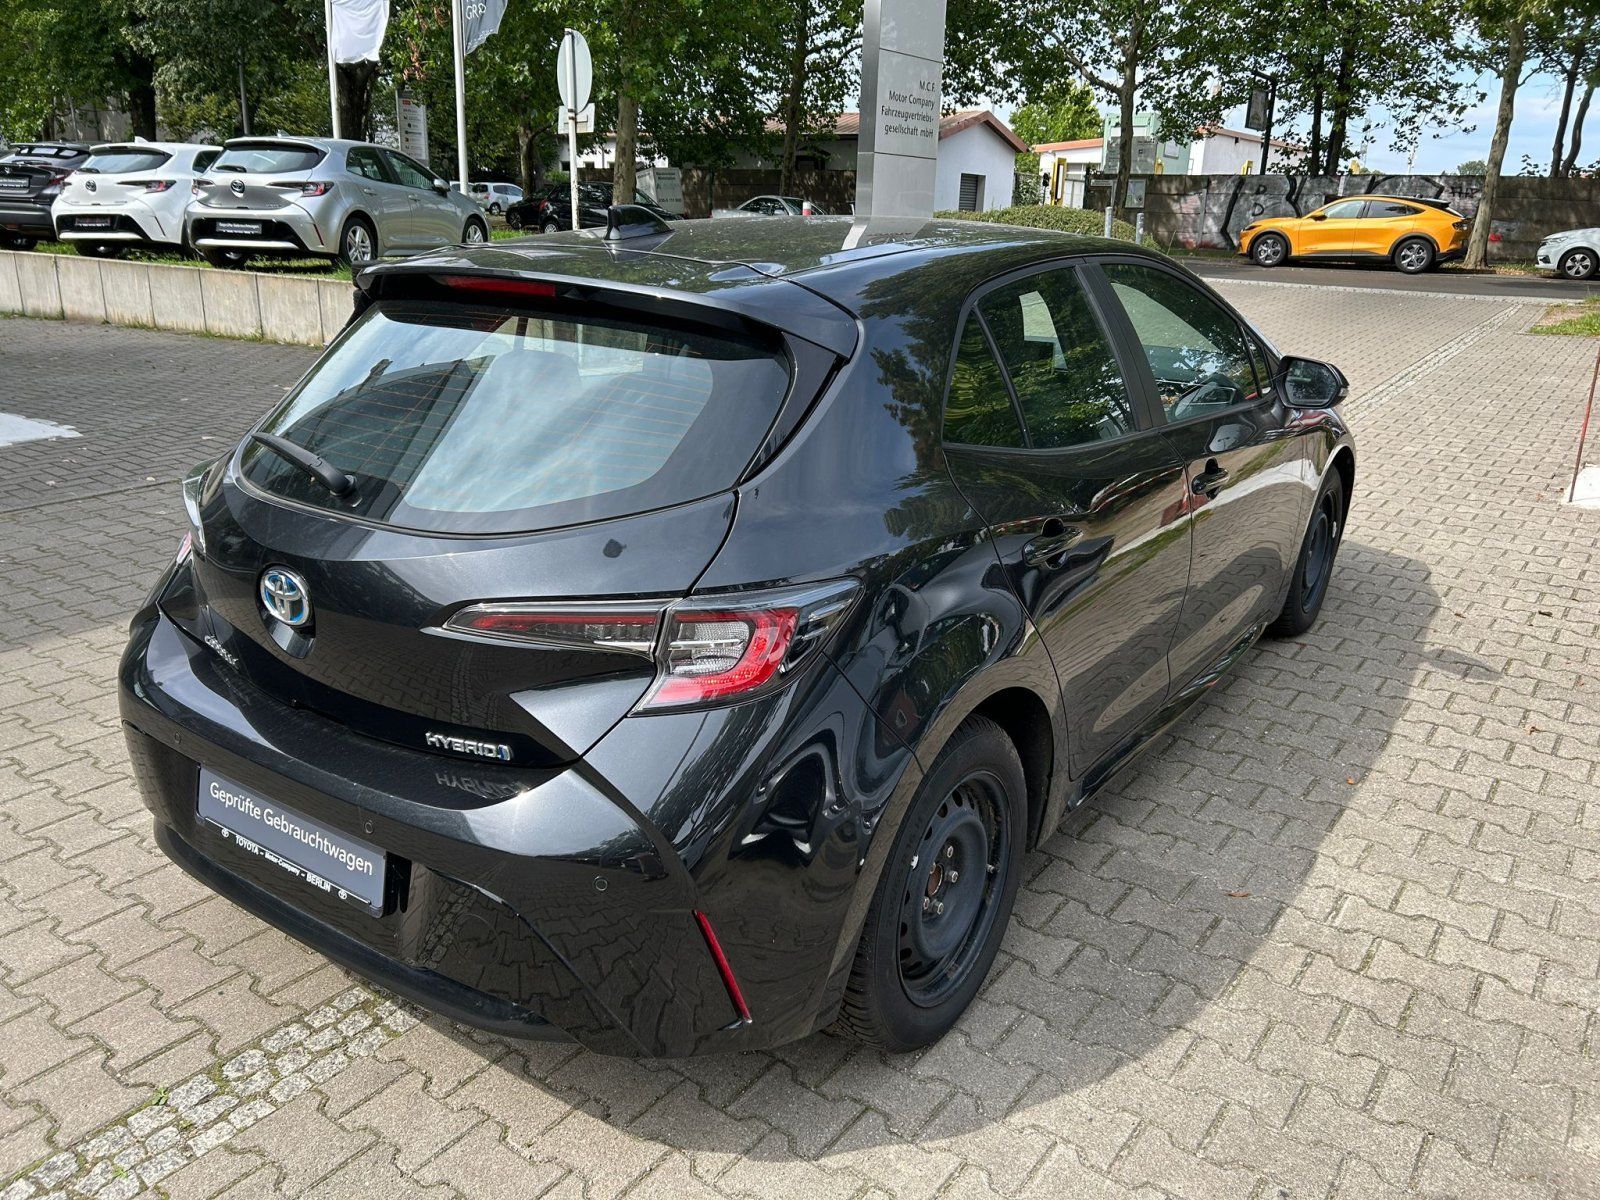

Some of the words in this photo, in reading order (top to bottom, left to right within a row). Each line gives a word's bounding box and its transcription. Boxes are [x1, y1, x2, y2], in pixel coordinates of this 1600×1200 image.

[889, 90, 908, 102] Motor
[908, 94, 935, 110] Company
[881, 105, 934, 122] Fahrzeugvertriebs-
[884, 124, 918, 136] gesellschaft
[920, 127, 934, 138] mbH
[425, 731, 497, 758] HYBRID
[209, 782, 261, 820] Geprüfte
[263, 808, 373, 876] Gebrauchtwagen
[235, 834, 259, 855] TOYOTA
[306, 871, 331, 893] BERLIN
